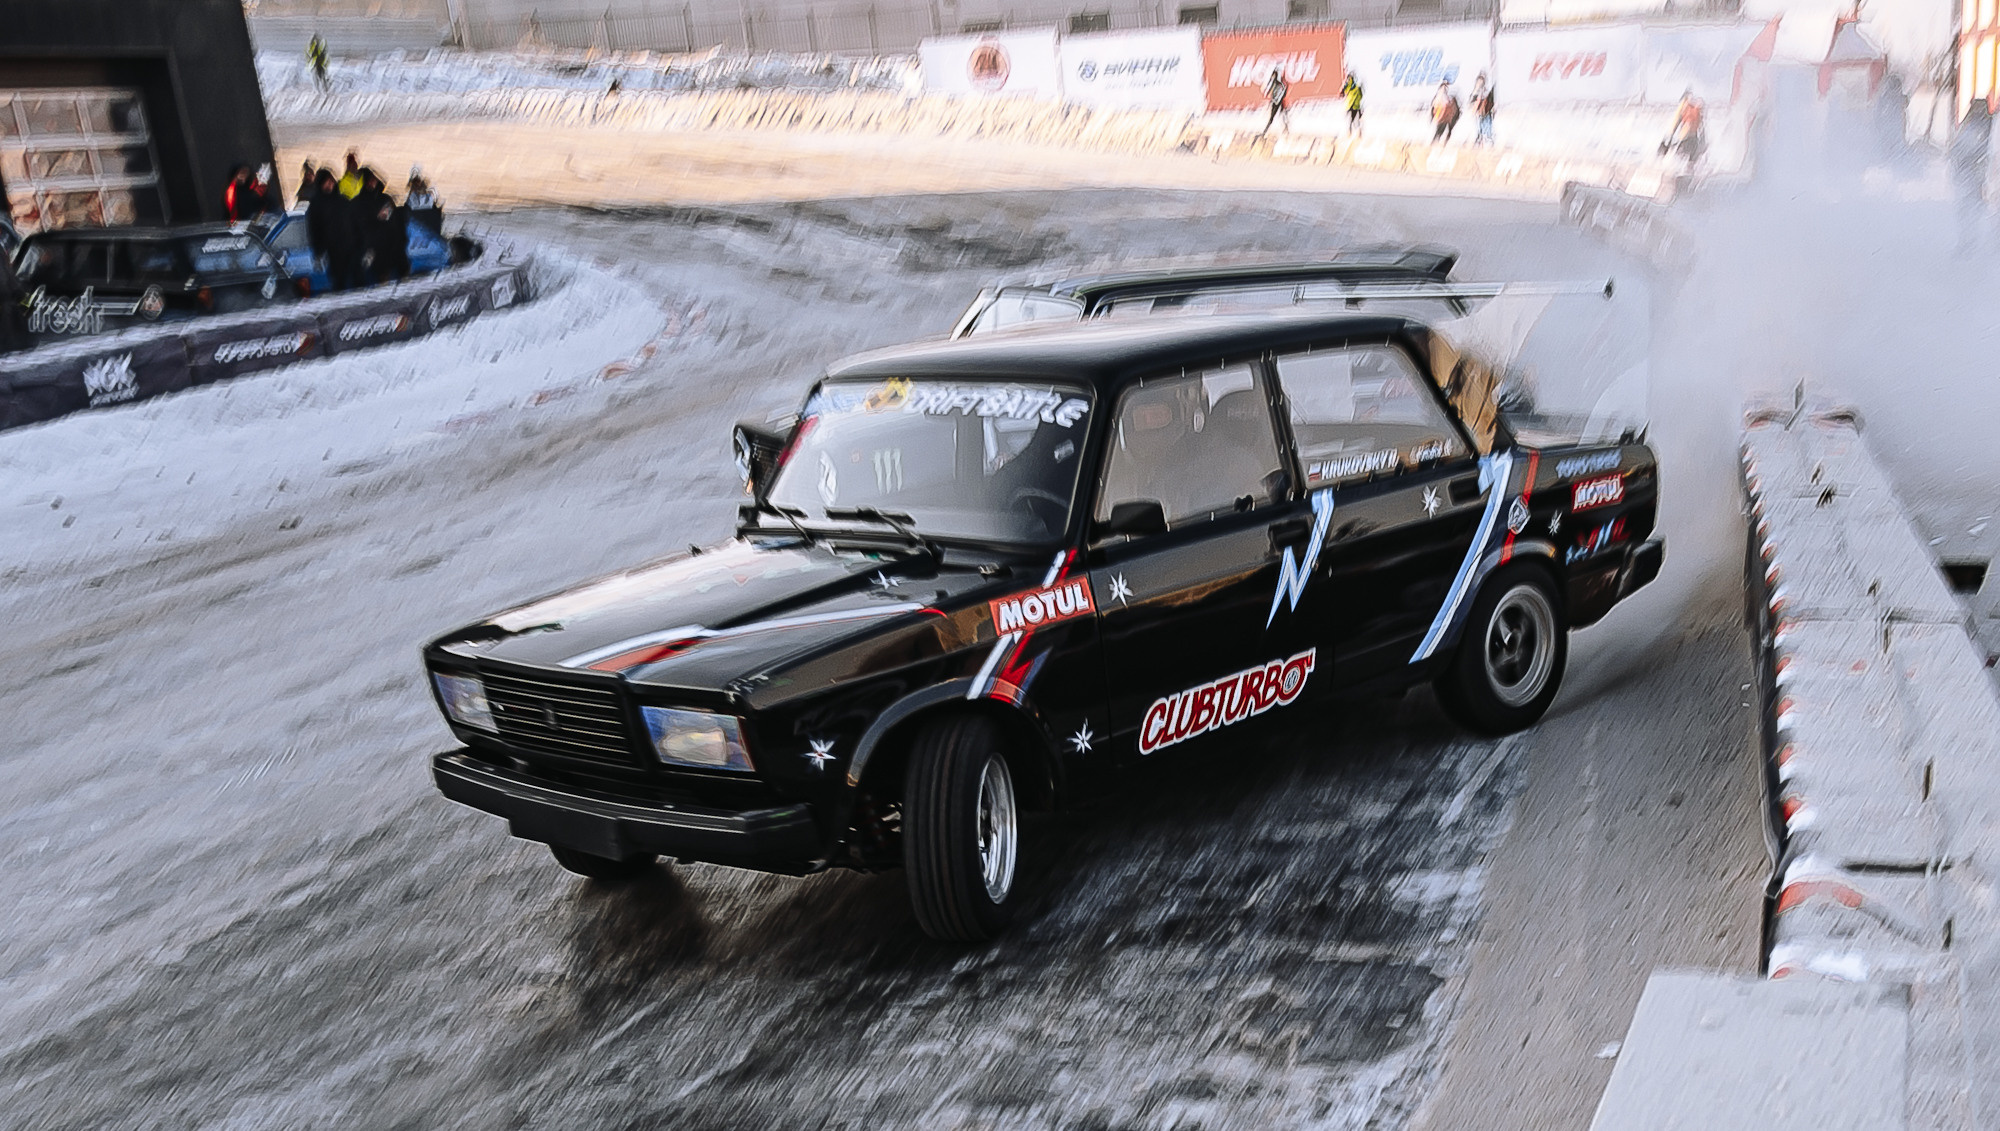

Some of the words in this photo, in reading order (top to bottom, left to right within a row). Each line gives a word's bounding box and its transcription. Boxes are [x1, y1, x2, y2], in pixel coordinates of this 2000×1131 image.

[1228, 51, 1321, 88] MOTUL
[1573, 475, 1624, 510] MOTUL
[1000, 581, 1089, 632] MOTUL
[1139, 647, 1317, 755] CLUBTURBO
